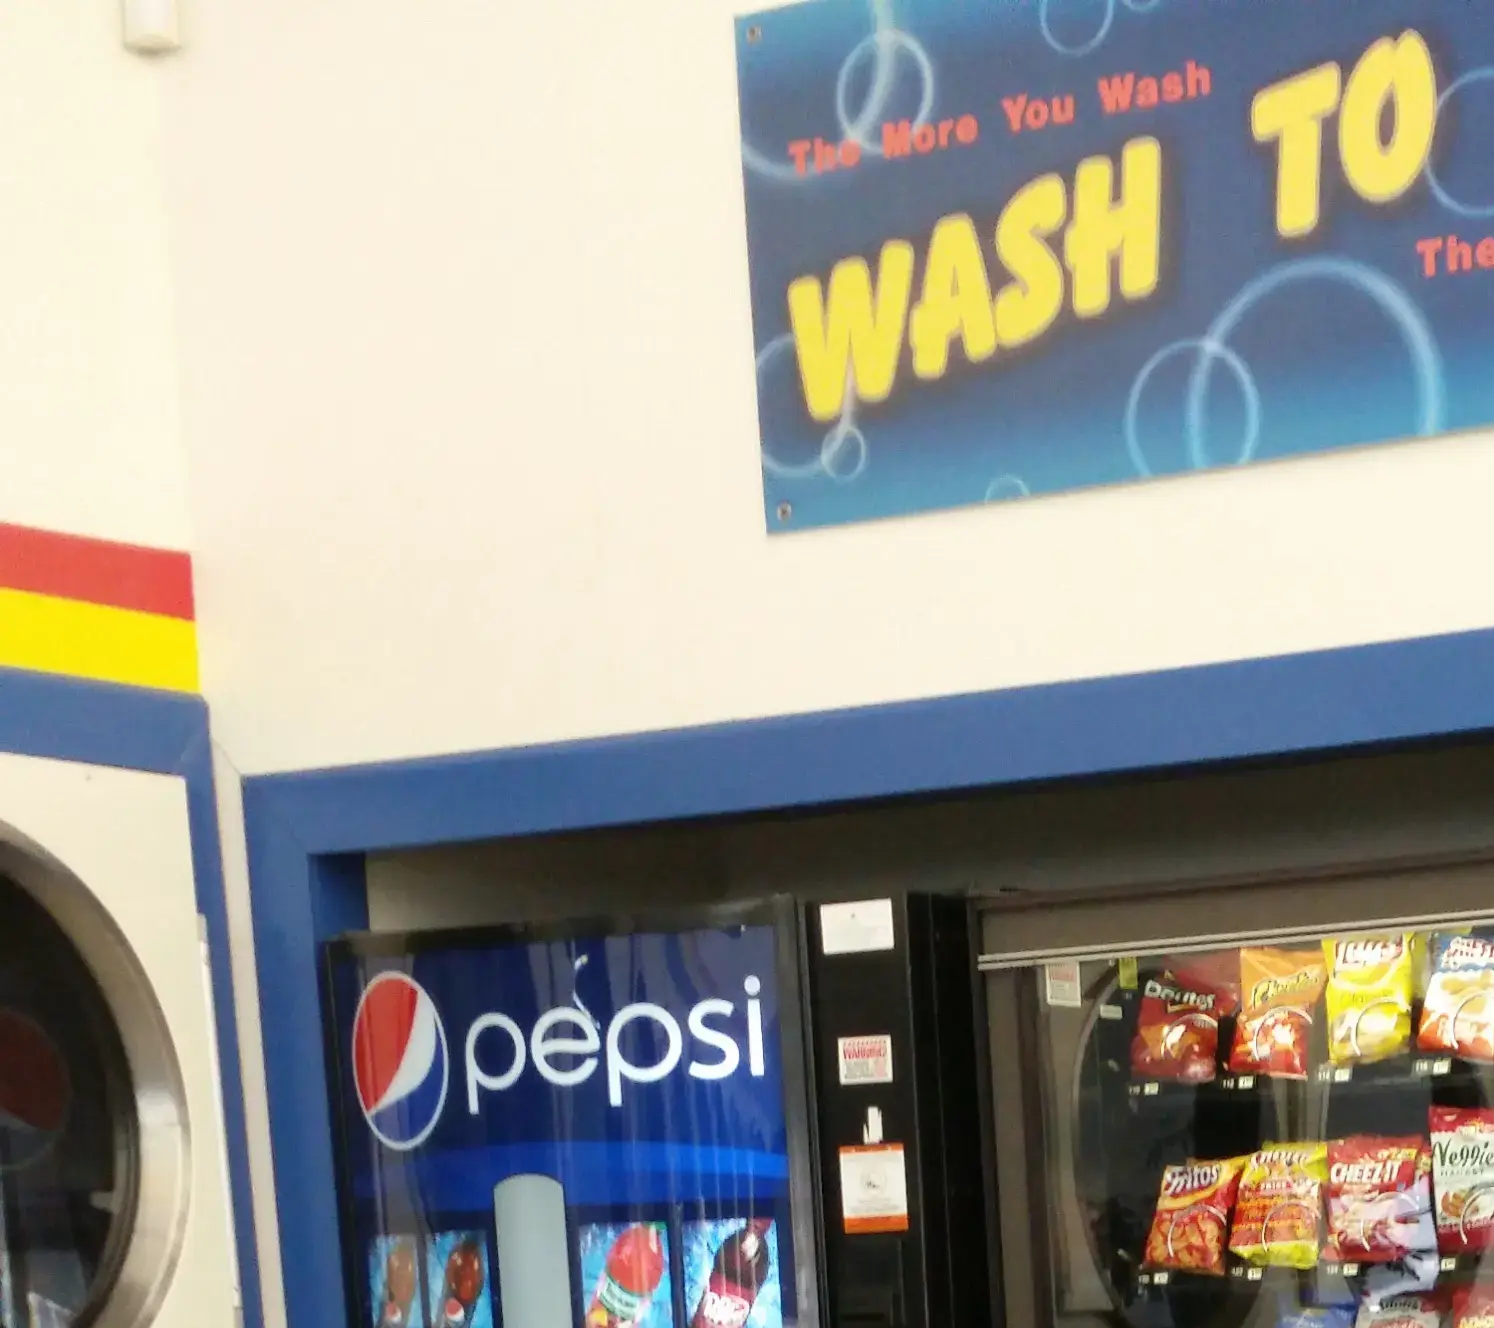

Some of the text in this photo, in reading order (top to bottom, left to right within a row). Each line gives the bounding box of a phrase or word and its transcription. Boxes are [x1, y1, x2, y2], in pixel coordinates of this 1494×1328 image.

[788, 60, 1212, 176] The More You Wash
[787, 136, 1162, 424] WASH
[1250, 28, 1438, 238] TO
[464, 974, 766, 1116] pepsi
